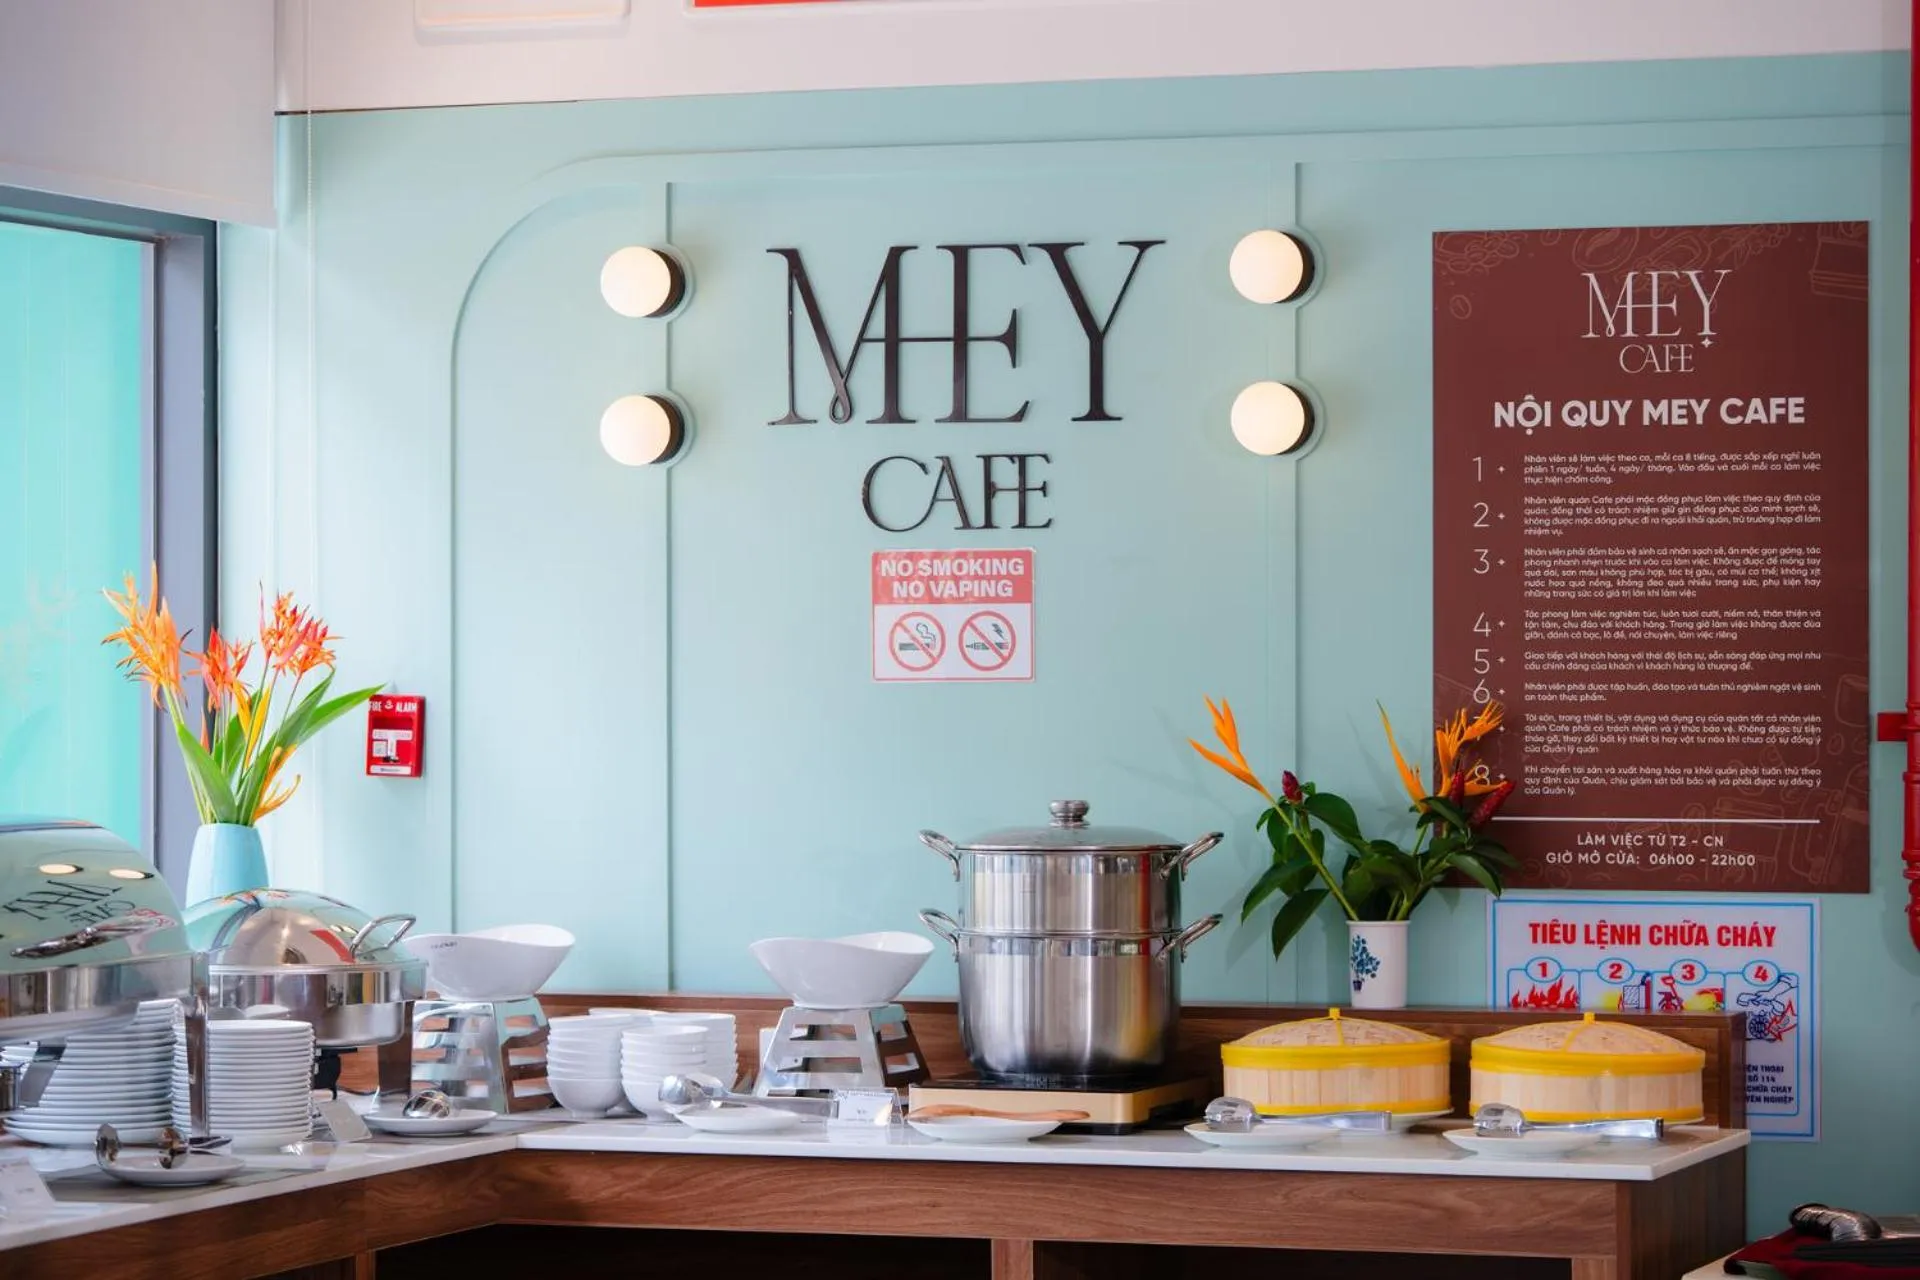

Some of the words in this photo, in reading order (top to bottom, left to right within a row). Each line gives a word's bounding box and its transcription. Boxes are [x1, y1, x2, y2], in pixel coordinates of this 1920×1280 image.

[1580, 269, 1732, 338] MEY
[766, 240, 1167, 426] MEY
[1619, 344, 1694, 374] CAFE
[1494, 395, 1551, 436] NỘI
[1562, 400, 1632, 428] QUY
[1643, 399, 1711, 426] MEY
[1720, 397, 1806, 424] CAFE
[1472, 457, 1482, 482] 1
[861, 453, 1052, 532] CAFE
[1473, 502, 1490, 527] 2
[881, 559, 913, 576] NO
[918, 558, 1024, 576] SMOKING
[1473, 548, 1490, 574] 3
[893, 581, 925, 598] NO
[930, 580, 1014, 598] VAPING
[1473, 612, 1491, 636] 4
[1474, 649, 1490, 674] 5
[1474, 679, 1490, 704] 6
[395, 701, 417, 712] ALARM
[1577, 832, 1605, 846] LÀM
[1611, 833, 1643, 849] VIỆC
[1648, 832, 1666, 846] TỪ
[1670, 836, 1686, 846] T2
[1703, 836, 1724, 846] CN
[1546, 850, 1573, 864] GIỜ
[1578, 850, 1601, 864] MỞ
[1606, 849, 1640, 865] CỬA:
[1649, 853, 1695, 865] 06h00
[1711, 854, 1755, 866] 22h00
[1528, 919, 1577, 945] TIÊU
[1584, 920, 1641, 950] LỆNH
[1649, 920, 1709, 946] CHỮA
[1717, 921, 1776, 948] CHÁY
[1538, 962, 1548, 977] 1
[1609, 963, 1623, 979] 2
[1682, 964, 1695, 980] 3
[1754, 966, 1768, 981] 4
